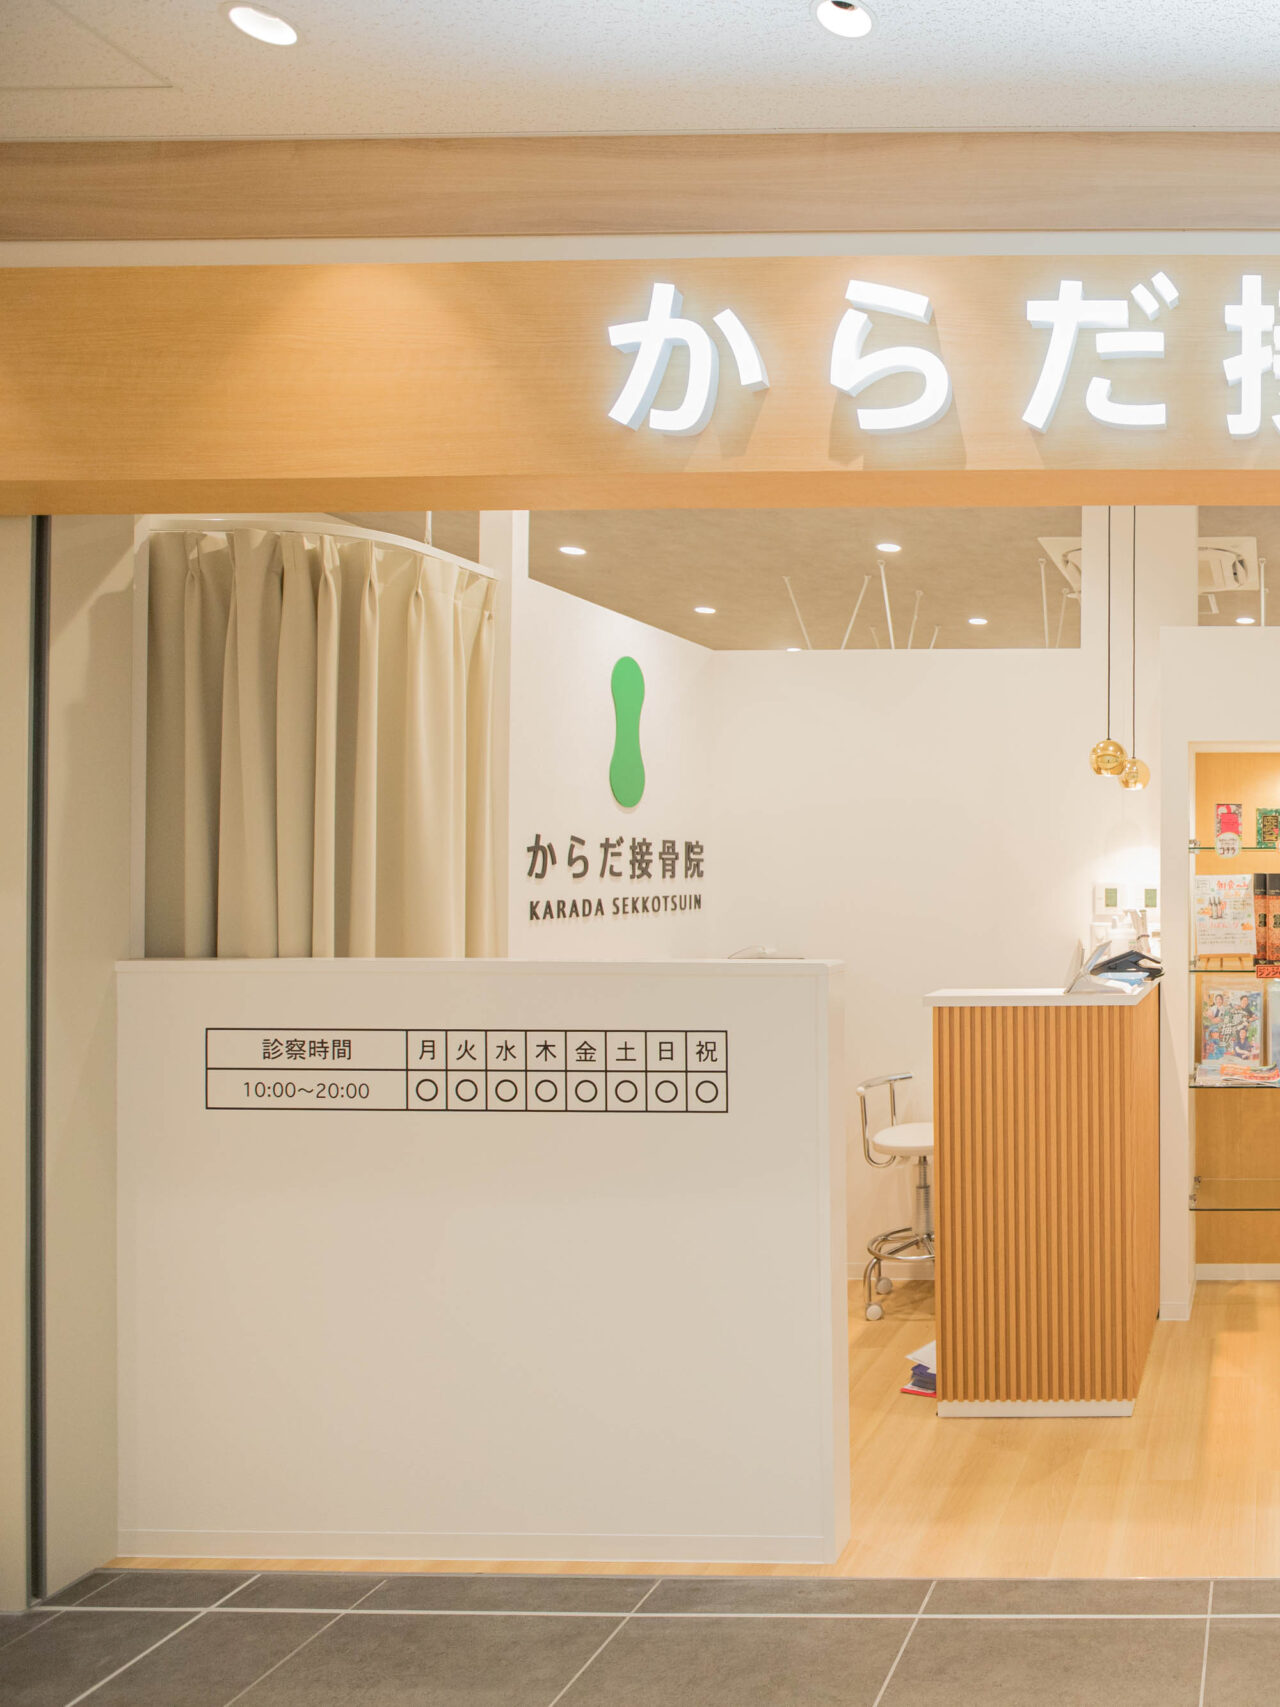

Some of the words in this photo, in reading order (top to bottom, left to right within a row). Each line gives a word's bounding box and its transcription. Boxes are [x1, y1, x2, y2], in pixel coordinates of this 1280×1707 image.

[526, 833, 705, 880] からだ接骨院
[529, 898, 605, 920] KARADA
[612, 894, 702, 915] SEKKOTSUIN
[262, 1037, 352, 1061] 診察時間
[418, 1039, 436, 1061] 月
[455, 1039, 477, 1061] 火
[495, 1039, 517, 1061] 水
[535, 1039, 557, 1062] 木
[575, 1040, 597, 1062] 金
[615, 1040, 637, 1062] 土
[658, 1041, 674, 1061] 日
[695, 1040, 718, 1062] 祝
